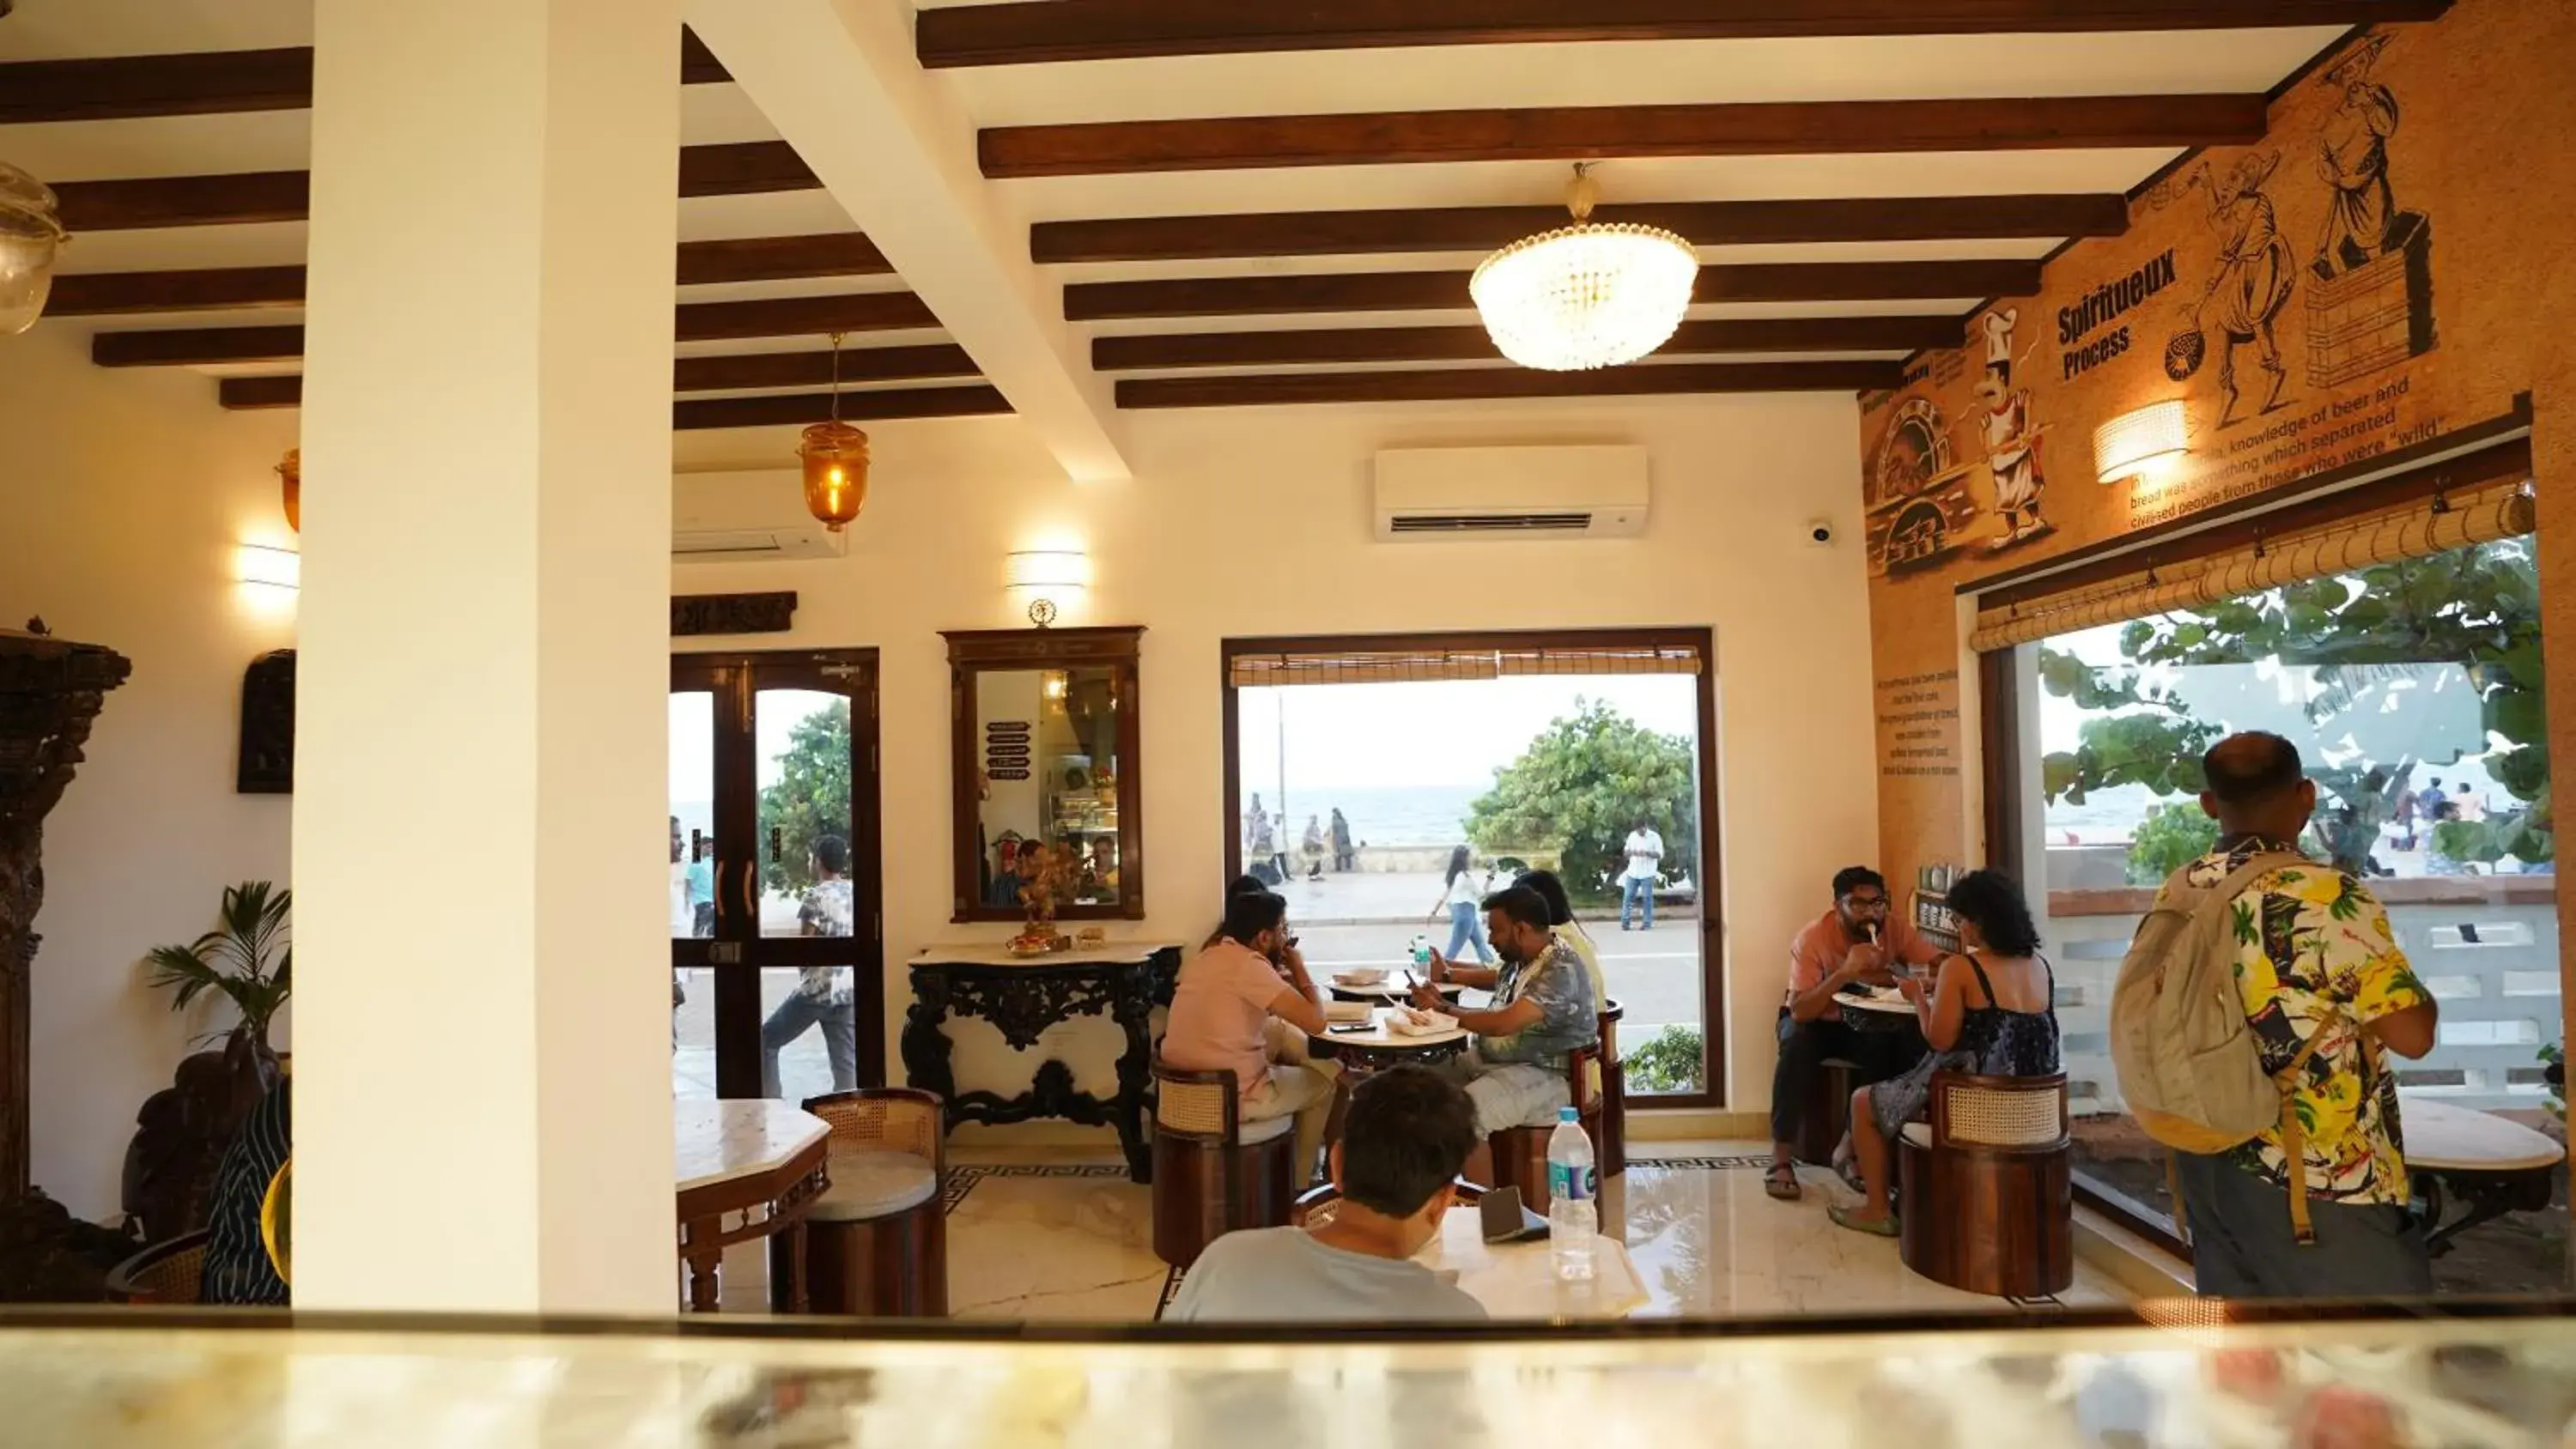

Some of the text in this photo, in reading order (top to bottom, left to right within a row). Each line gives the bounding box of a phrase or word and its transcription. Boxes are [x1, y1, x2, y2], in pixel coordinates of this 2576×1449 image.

[2059, 248, 2176, 344] Spiritueux
[2064, 326, 2129, 379] Process
[2230, 417, 2308, 452] knowledge
[2312, 408, 2326, 425] of
[2333, 395, 2370, 416] beer
[2376, 376, 2409, 401] and
[2130, 488, 2161, 510] bread
[2263, 438, 2306, 465] which
[2312, 408, 2396, 449] separated
[2178, 491, 2220, 515] people
[2222, 481, 2256, 500] from
[2304, 455, 2338, 476] who
[2342, 440, 2385, 464] were
